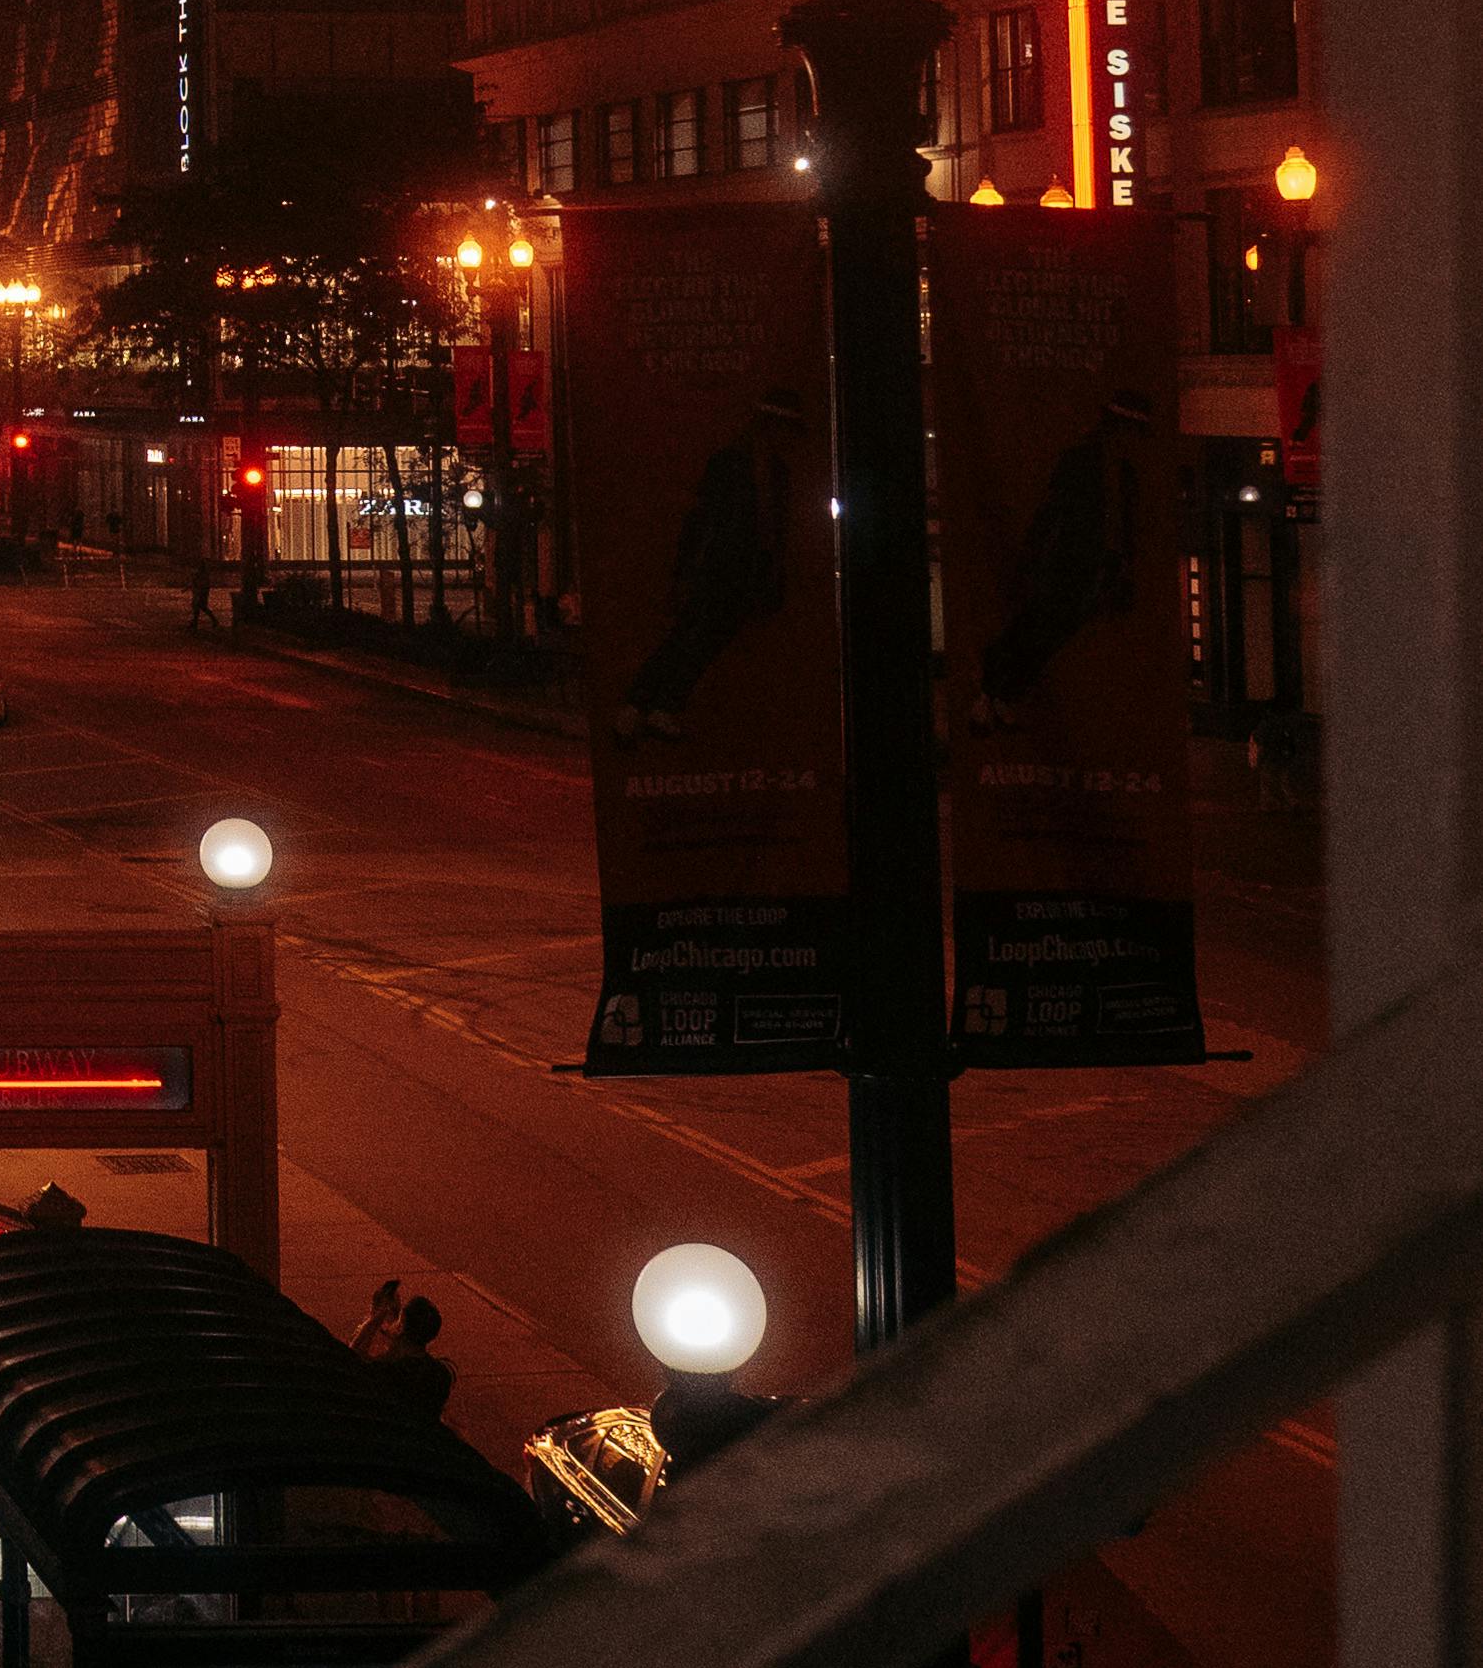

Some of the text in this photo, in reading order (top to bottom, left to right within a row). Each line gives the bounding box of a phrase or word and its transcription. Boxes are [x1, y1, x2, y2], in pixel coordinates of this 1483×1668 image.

[178, 52, 189, 173] BLOCK
[1106, 49, 1134, 206] SISKE
[625, 772, 733, 798] AUGUST
[631, 939, 818, 975] LoopChicago.com
[661, 1009, 718, 1032] LOOP
[1026, 1001, 1083, 1024] LOOP
[660, 1033, 718, 1047] ALLIANCE
